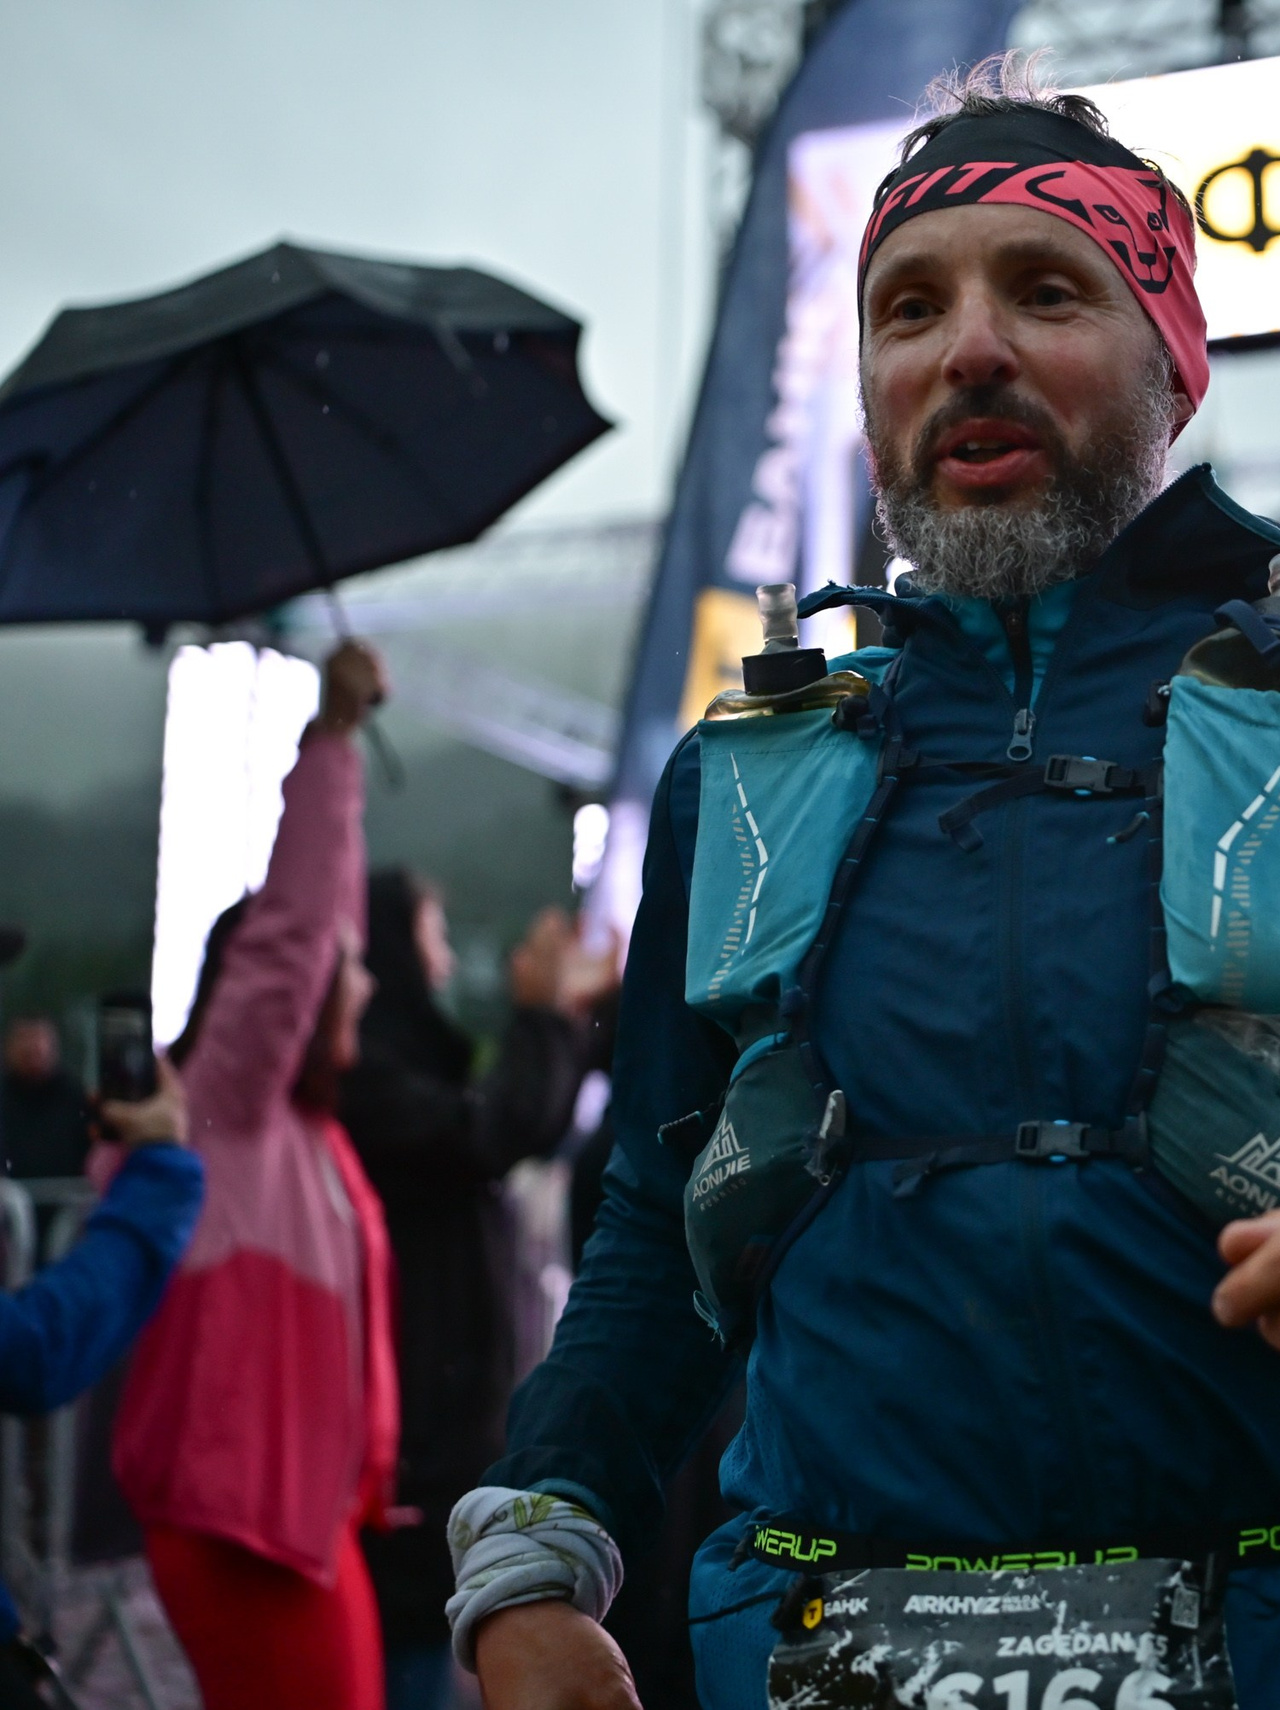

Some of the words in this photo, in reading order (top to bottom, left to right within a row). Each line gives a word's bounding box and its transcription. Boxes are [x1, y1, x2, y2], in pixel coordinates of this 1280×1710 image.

[692, 1154, 751, 1202] AONIJIE
[903, 1595, 1000, 1614] ARKHYZ
[997, 1631, 1135, 1657] ZAGEDAN
